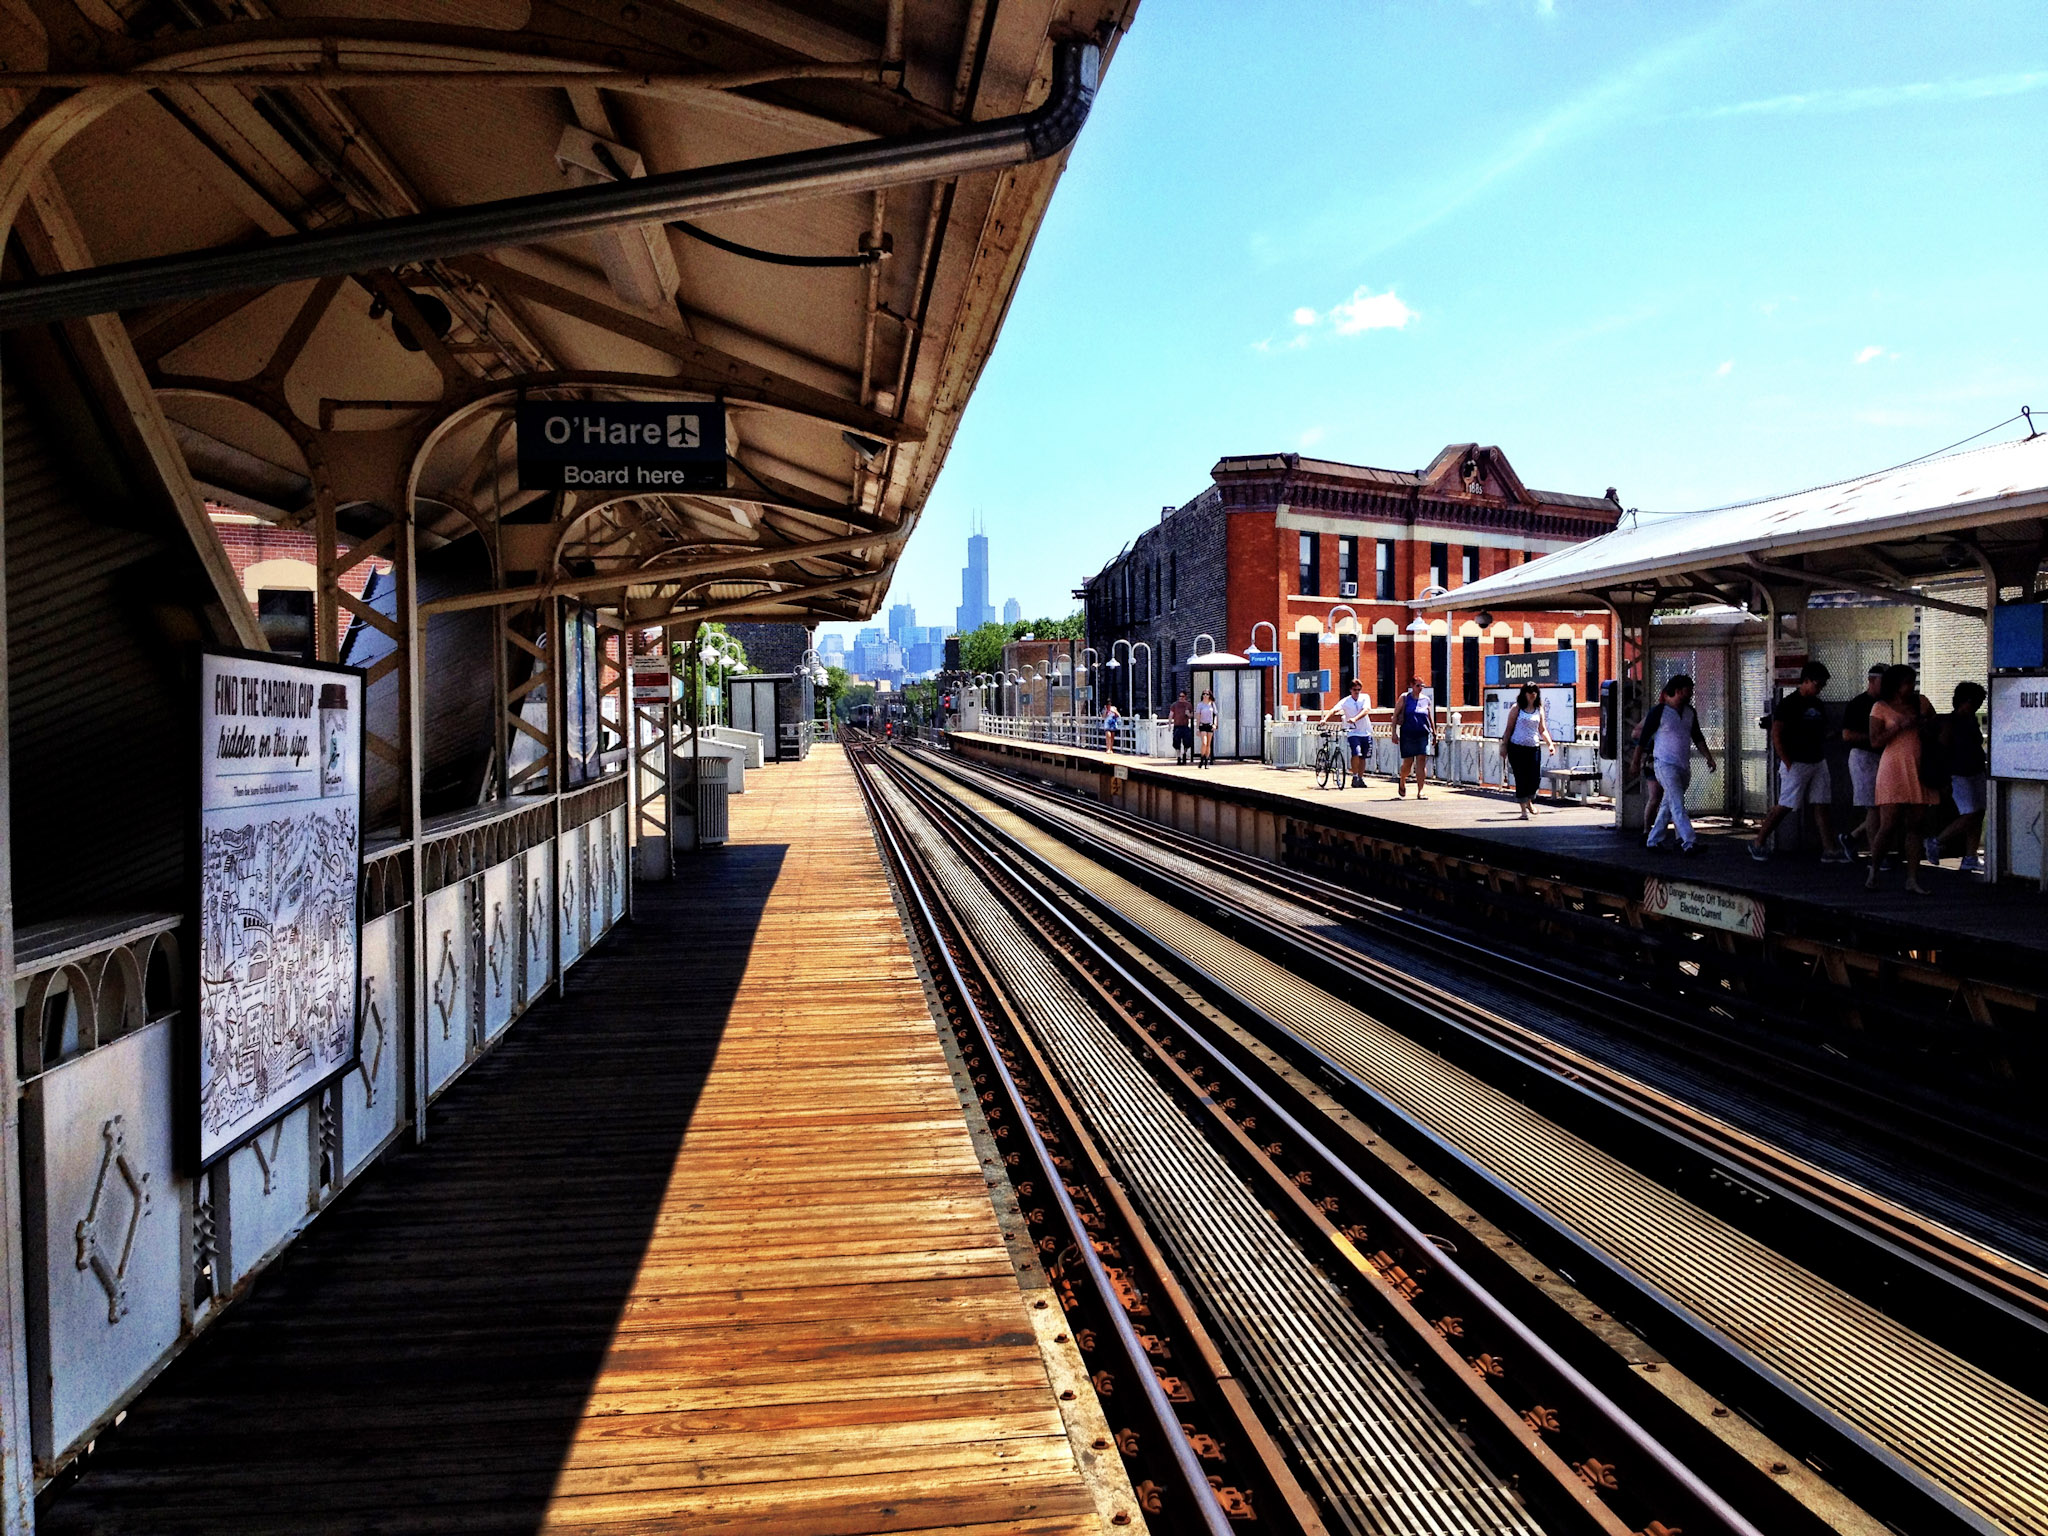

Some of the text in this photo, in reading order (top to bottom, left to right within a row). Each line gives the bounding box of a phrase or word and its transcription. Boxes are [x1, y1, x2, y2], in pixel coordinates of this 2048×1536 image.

[544, 415, 662, 445] O'Hare
[564, 465, 685, 484] Board here
[1505, 660, 1533, 679] Damen
[215, 674, 314, 719] FIND THE CARIBOU CUP
[2020, 691, 2038, 708] BLUE
[216, 724, 257, 759] hidden
[258, 734, 272, 758] on
[273, 726, 289, 757] this
[1680, 901, 1722, 920] Electric Current
[1716, 895, 1736, 910] Tracks
